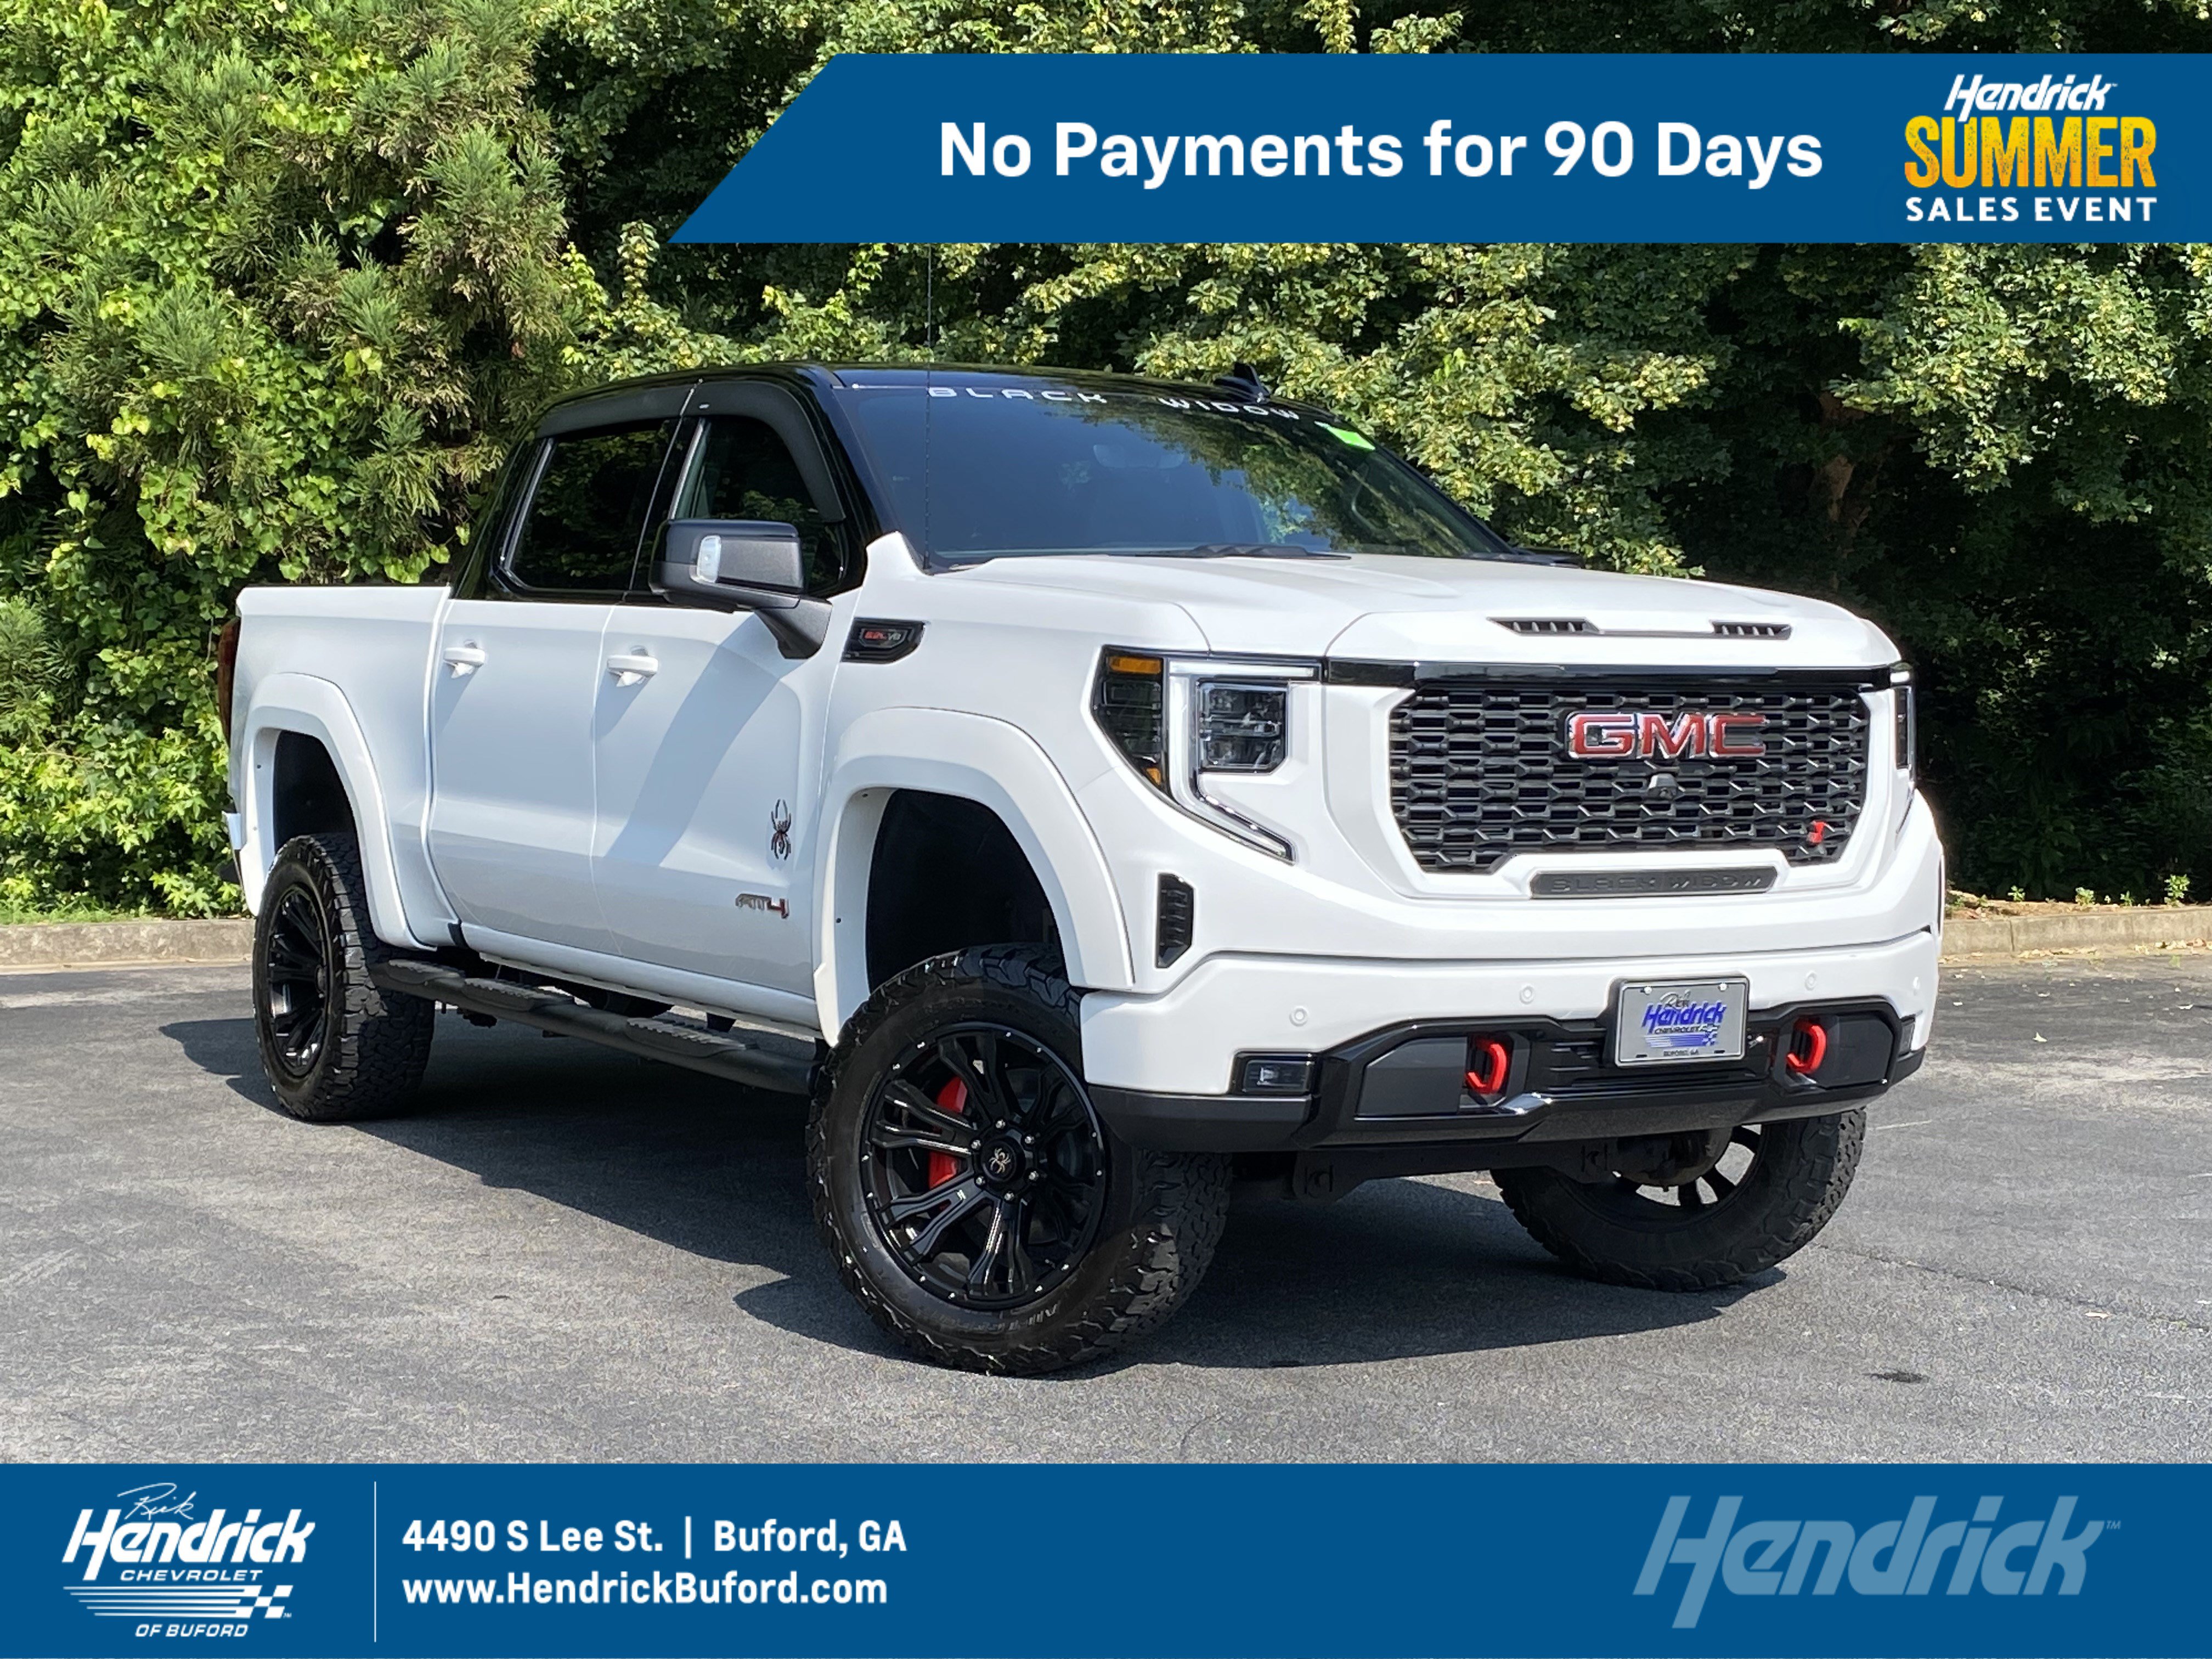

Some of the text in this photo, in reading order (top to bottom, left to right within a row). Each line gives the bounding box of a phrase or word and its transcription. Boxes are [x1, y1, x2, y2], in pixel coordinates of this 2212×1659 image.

[928, 386, 1300, 420] BLACK WIDOW
[1565, 712, 1766, 759] GMC
[1641, 1000, 1727, 1034] Hendrick
